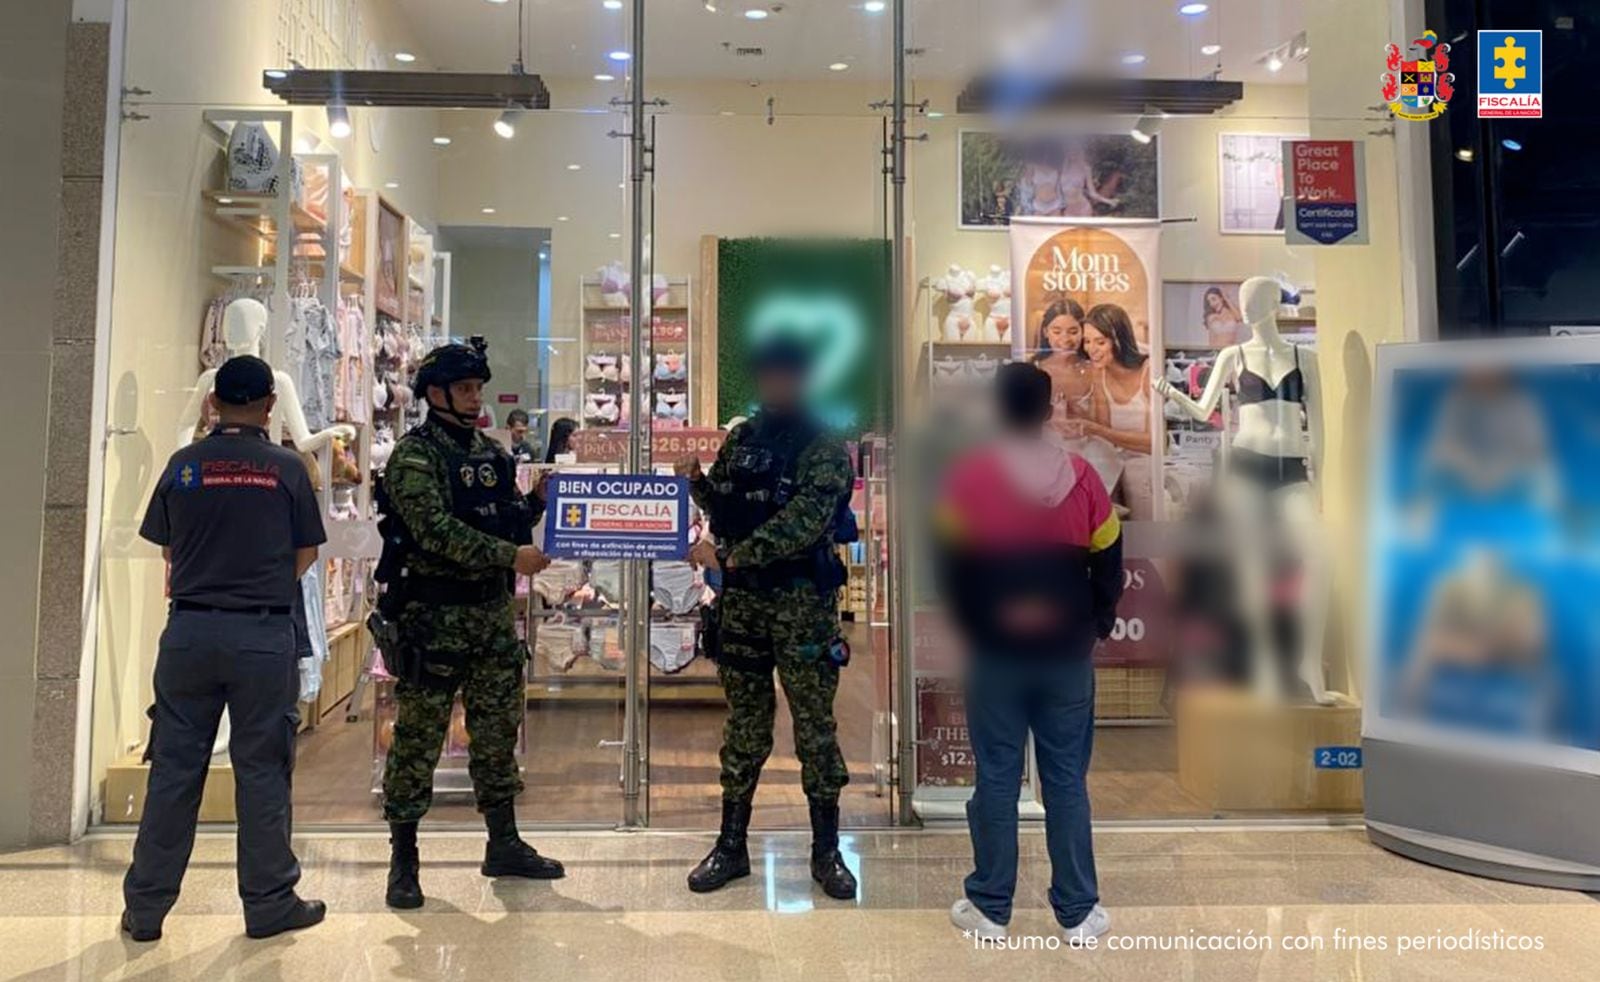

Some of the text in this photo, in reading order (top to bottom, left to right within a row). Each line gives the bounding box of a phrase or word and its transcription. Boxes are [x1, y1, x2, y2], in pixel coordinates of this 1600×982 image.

[1296, 144, 1339, 157] Great
[1297, 158, 1339, 170] Place
[1297, 172, 1314, 185] To
[1052, 246, 1119, 272] Mom
[1043, 265, 1130, 292] stories
[1185, 435, 1213, 446] Panty
[558, 481, 679, 496] BIEN OCUPADO
[591, 503, 671, 517] FISCALÍA
[572, 541, 588, 549] fines
[590, 541, 600, 549] de
[636, 542, 646, 550] de
[581, 549, 621, 558] disposición
[940, 752, 976, 766] $12.
[1321, 750, 1358, 766] 2-02
